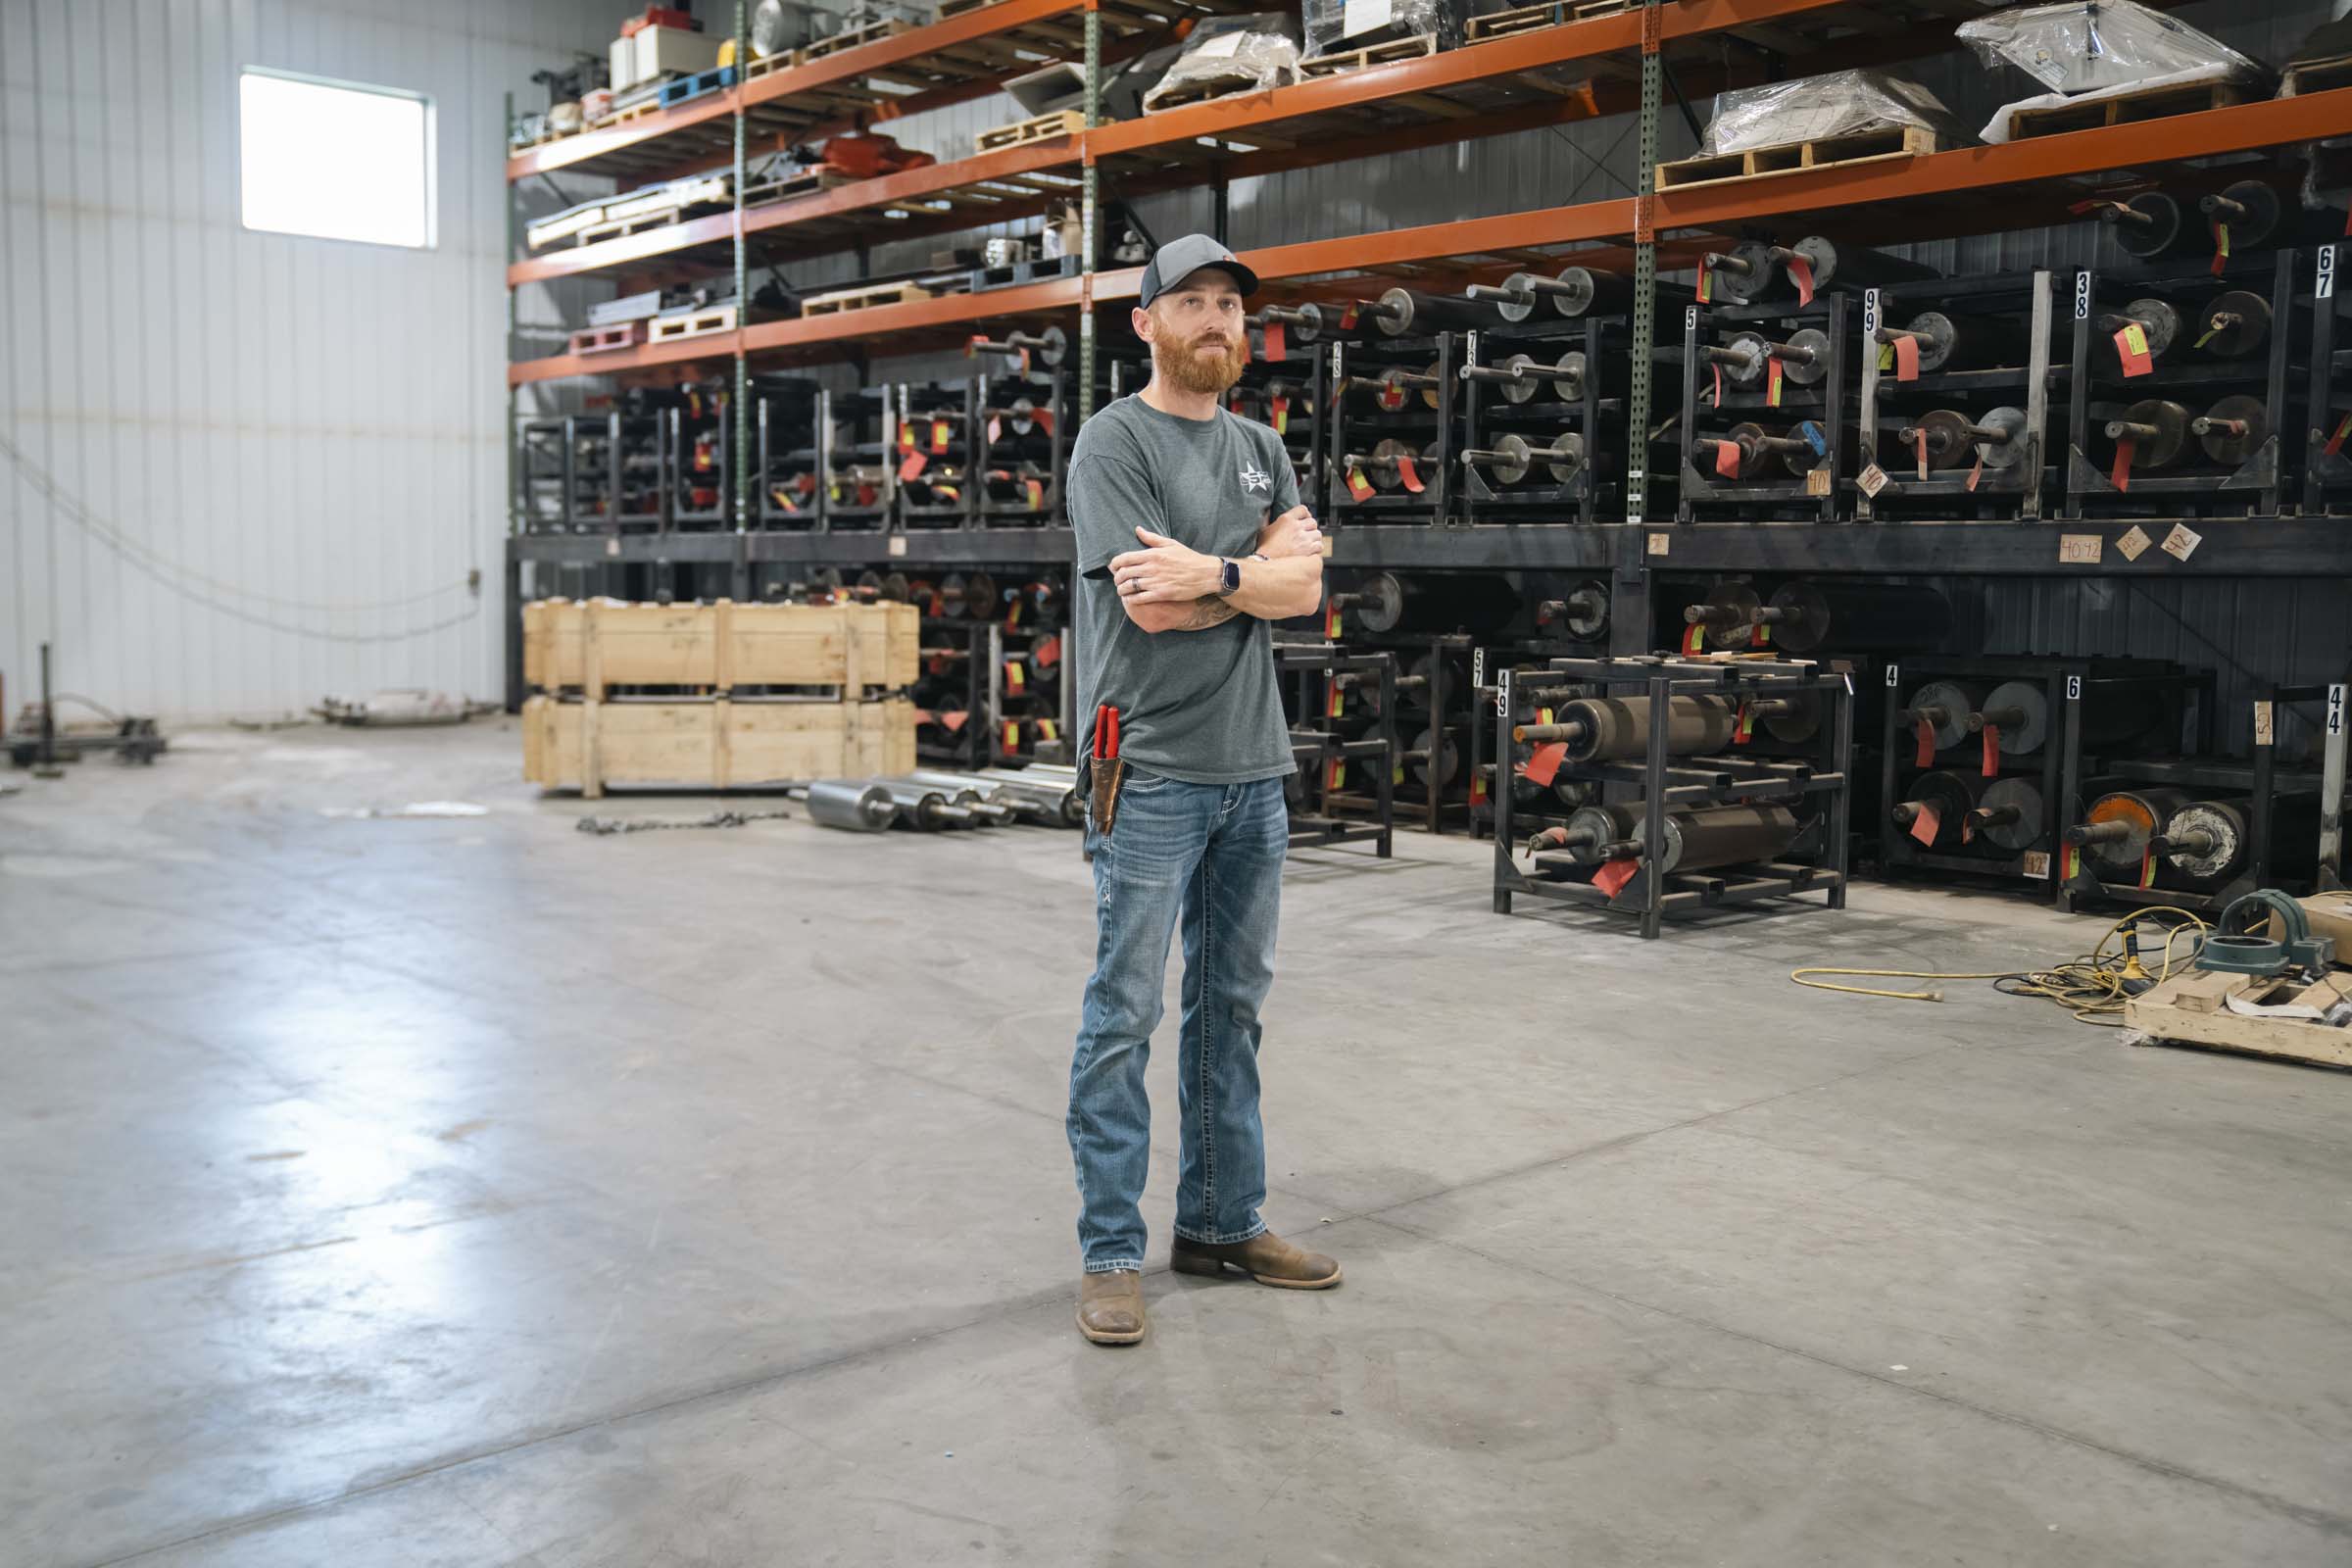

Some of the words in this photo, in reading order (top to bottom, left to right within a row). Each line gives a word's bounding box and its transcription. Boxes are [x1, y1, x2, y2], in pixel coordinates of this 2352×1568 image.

[2319, 247, 2331, 297] 67
[1865, 290, 1876, 332] 99
[2077, 273, 2087, 318] 38
[1687, 309, 1694, 327] 5
[1468, 332, 1476, 367] 73
[1474, 651, 1482, 686] 57
[1887, 666, 1895, 685] 4
[2069, 677, 2079, 698] 6
[1498, 671, 1507, 715] 49
[2328, 686, 2342, 734] 44
